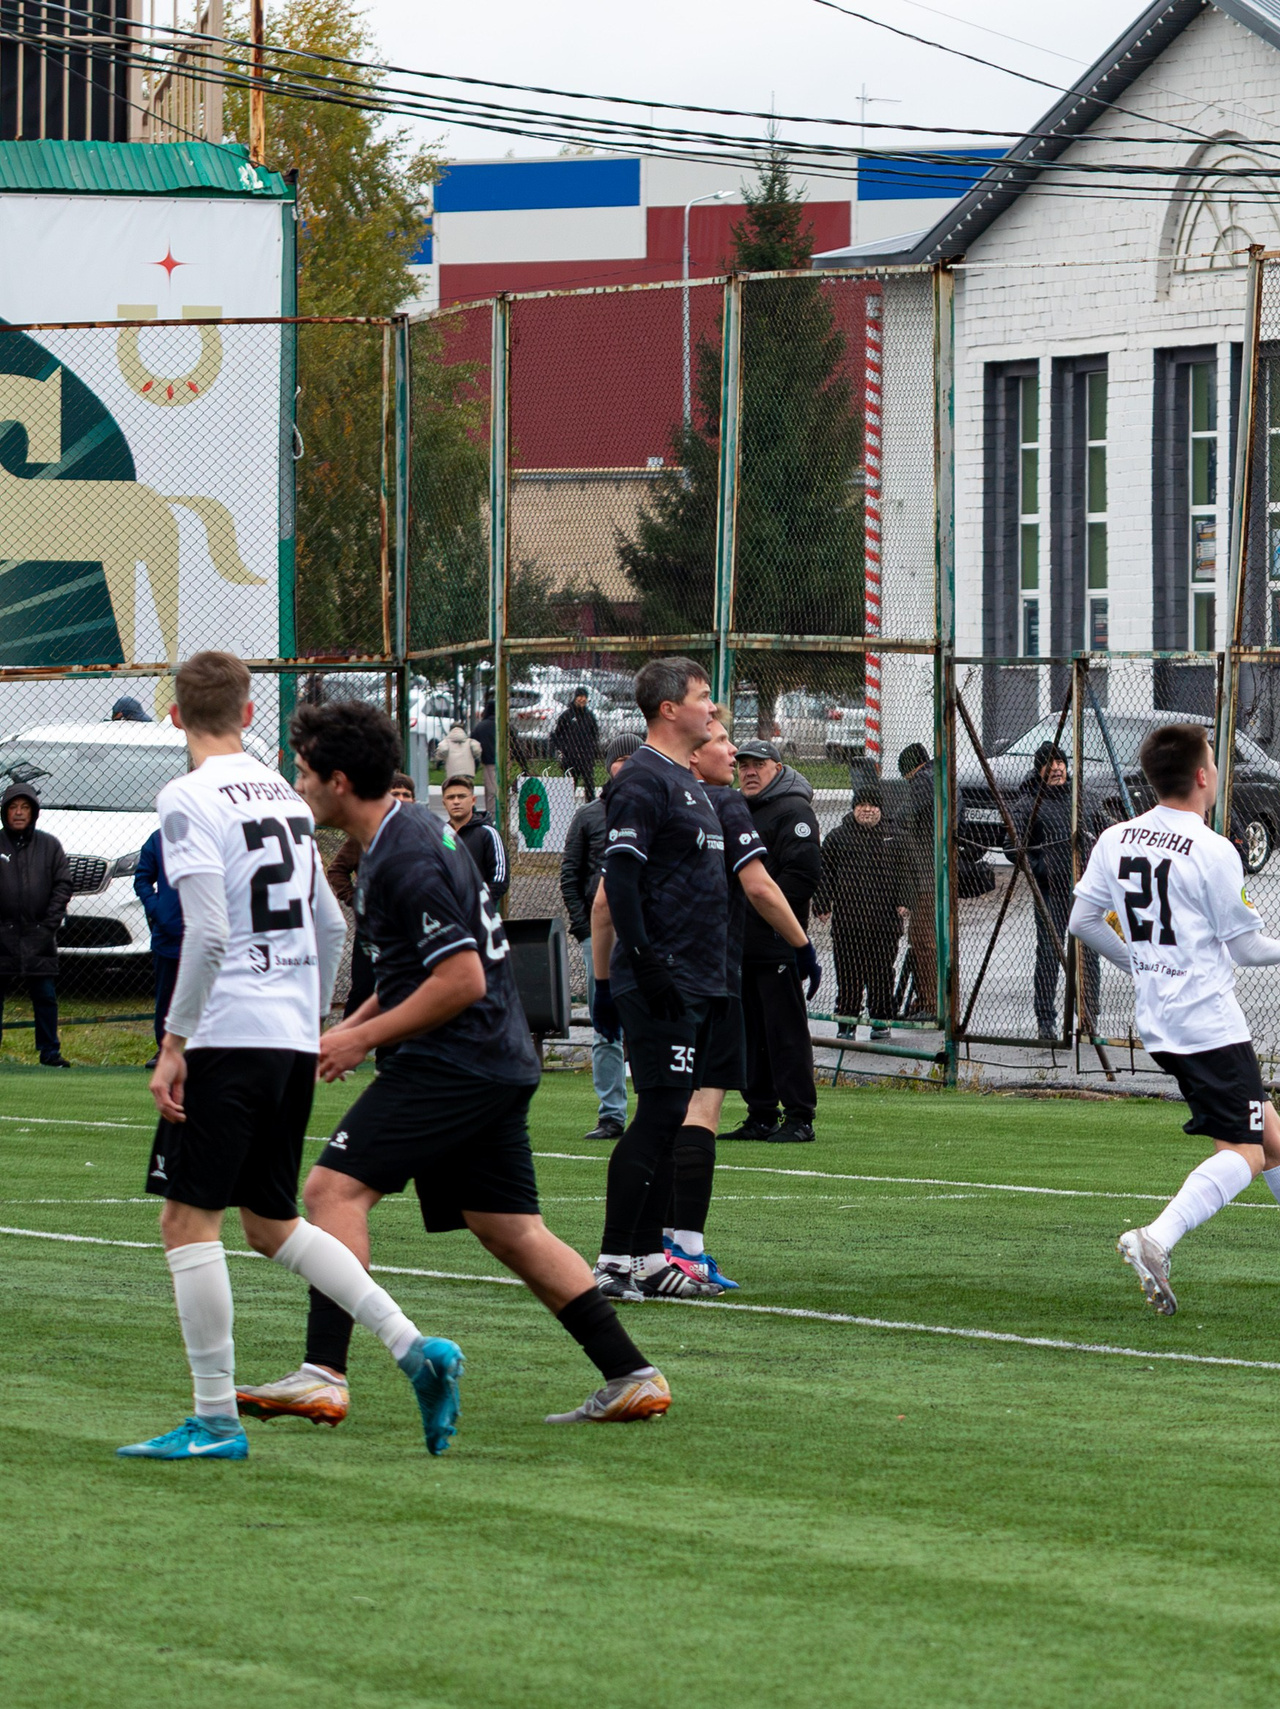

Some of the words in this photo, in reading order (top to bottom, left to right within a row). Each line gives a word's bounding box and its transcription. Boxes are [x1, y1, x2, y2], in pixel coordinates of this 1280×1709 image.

[1120, 828, 1194, 856] ТУРБИНА
[242, 817, 316, 933] 27
[1118, 856, 1177, 946] 21
[670, 1045, 695, 1073] 35
